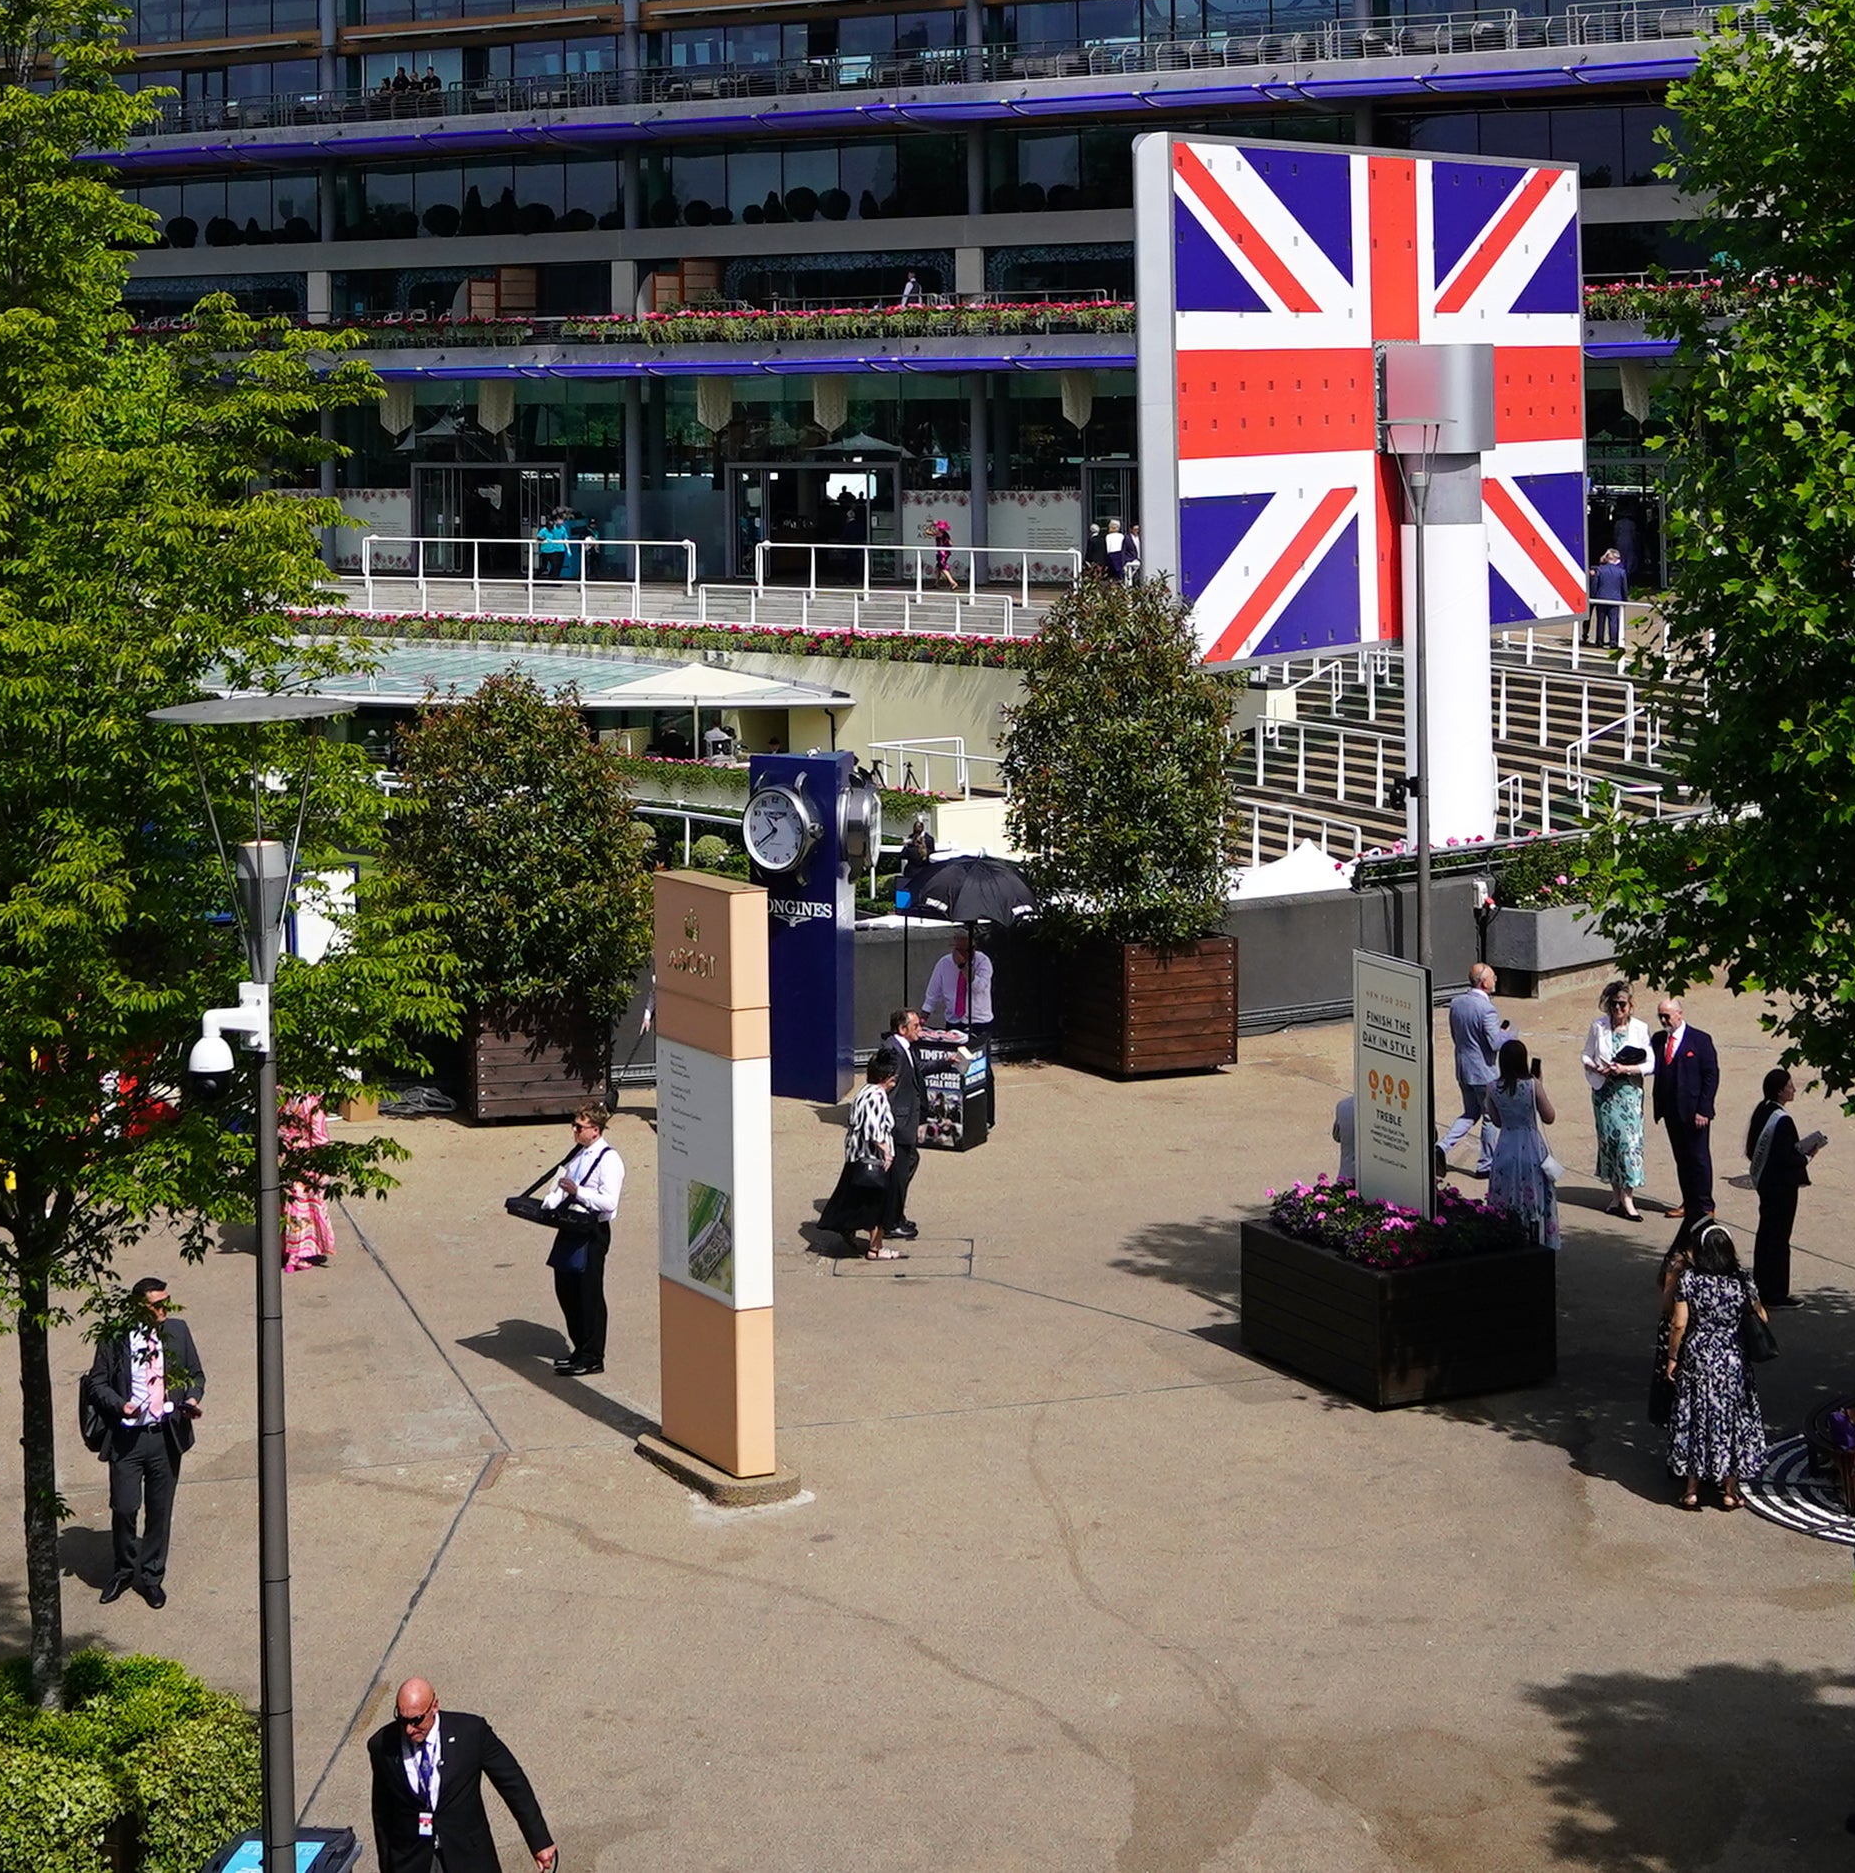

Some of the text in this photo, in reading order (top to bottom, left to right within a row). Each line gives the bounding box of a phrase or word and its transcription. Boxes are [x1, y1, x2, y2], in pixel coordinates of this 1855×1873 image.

[768, 899, 833, 918] ONGINES
[668, 947, 717, 979] ASCOT
[1366, 1010, 1411, 1034] FINISH THE
[1362, 1031, 1416, 1057] DAY IN STYLE
[1376, 1108, 1402, 1127] TREBLE
